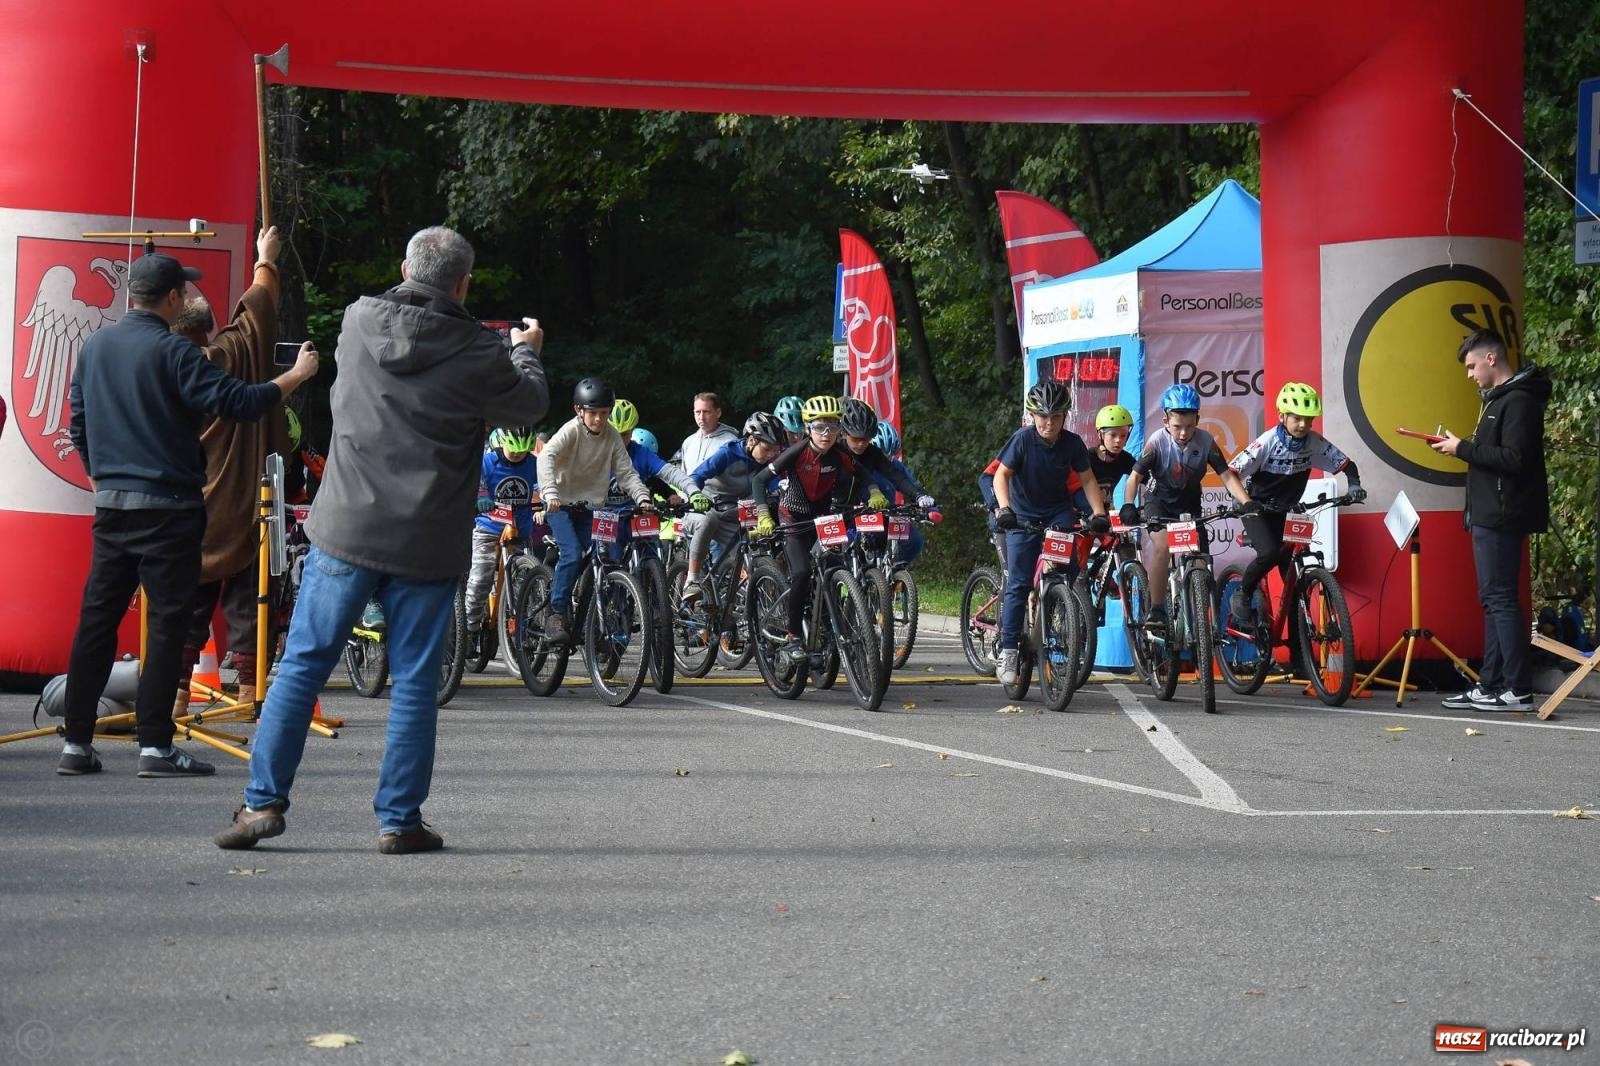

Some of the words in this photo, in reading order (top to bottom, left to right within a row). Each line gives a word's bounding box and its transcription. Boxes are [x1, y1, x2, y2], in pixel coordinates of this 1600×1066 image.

[640, 517, 652, 527] 61
[860, 514, 878, 523] 60
[823, 524, 840, 535] 65
[1291, 524, 1307, 534] 67
[1174, 532, 1191, 543] 59
[1050, 541, 1066, 553] 98
